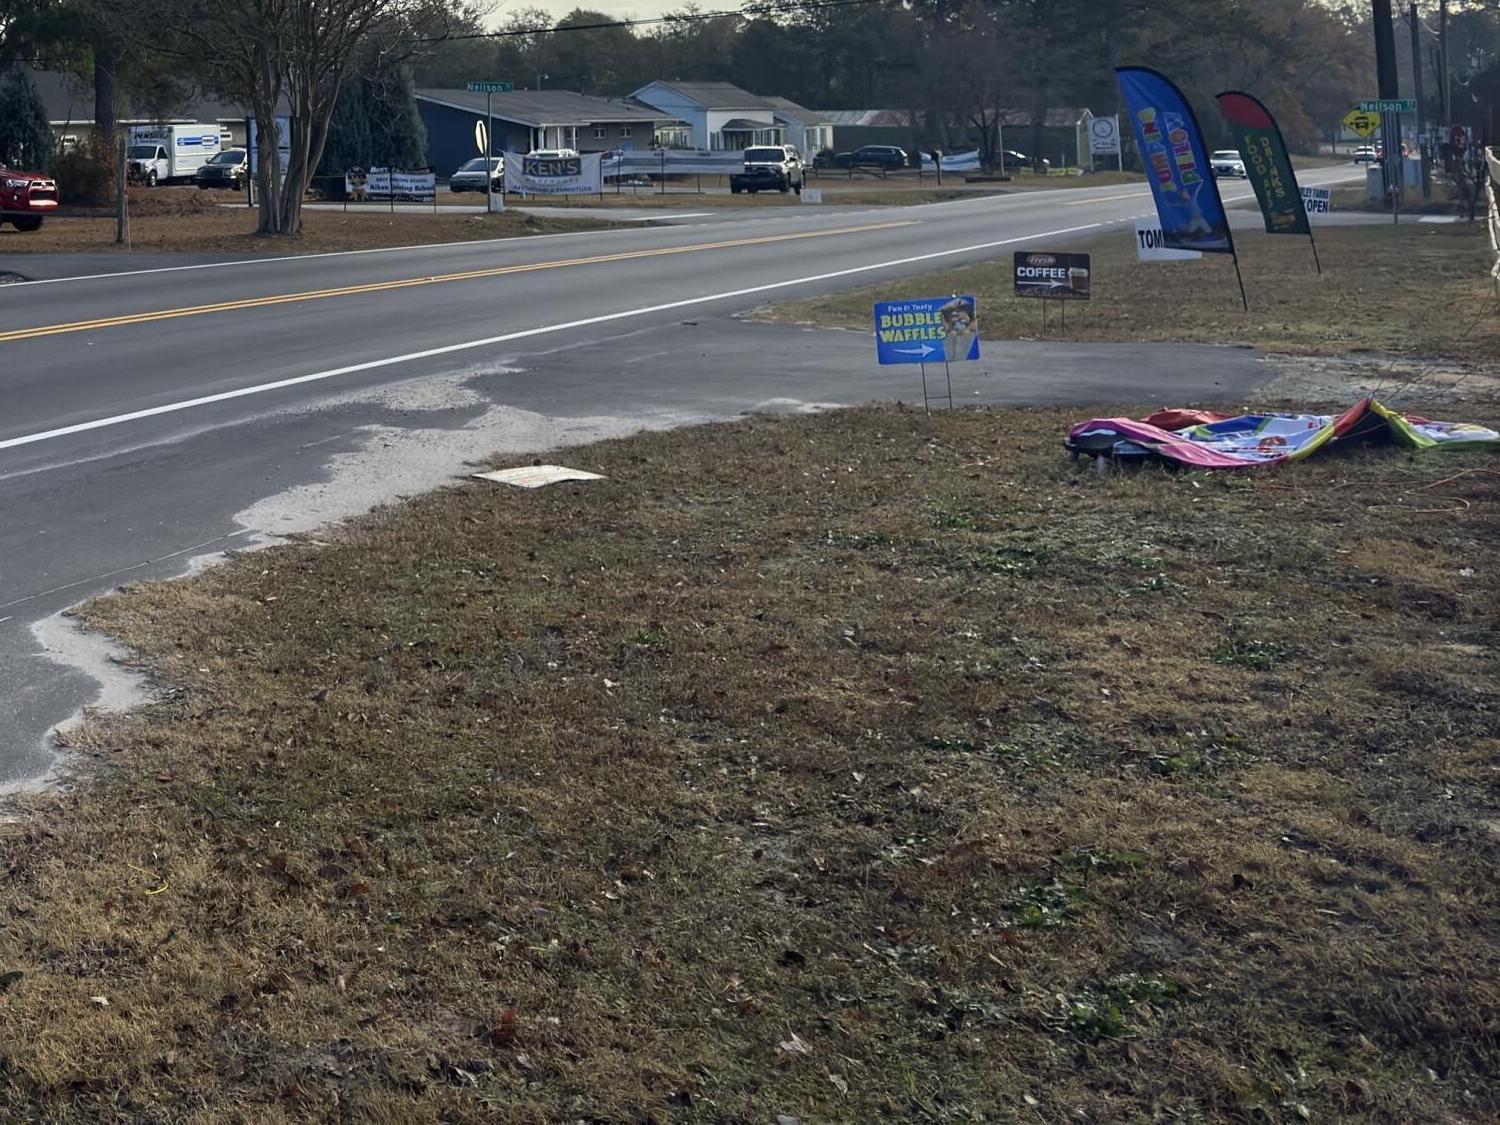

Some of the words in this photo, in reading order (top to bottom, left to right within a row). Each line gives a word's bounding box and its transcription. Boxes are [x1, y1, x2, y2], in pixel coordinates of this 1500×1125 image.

[1361, 101, 1402, 111] Neilson
[1244, 134, 1267, 176] FOOD
[525, 160, 578, 176] KEN'S
[1260, 137, 1285, 199] DRINKS
[1307, 199, 1329, 214] OPEN
[1016, 266, 1066, 278] COFFEE
[887, 305, 903, 313] Fun
[911, 303, 933, 312] Tasty
[880, 312, 942, 328] BUBBLE
[878, 326, 947, 343] WAFFLES
